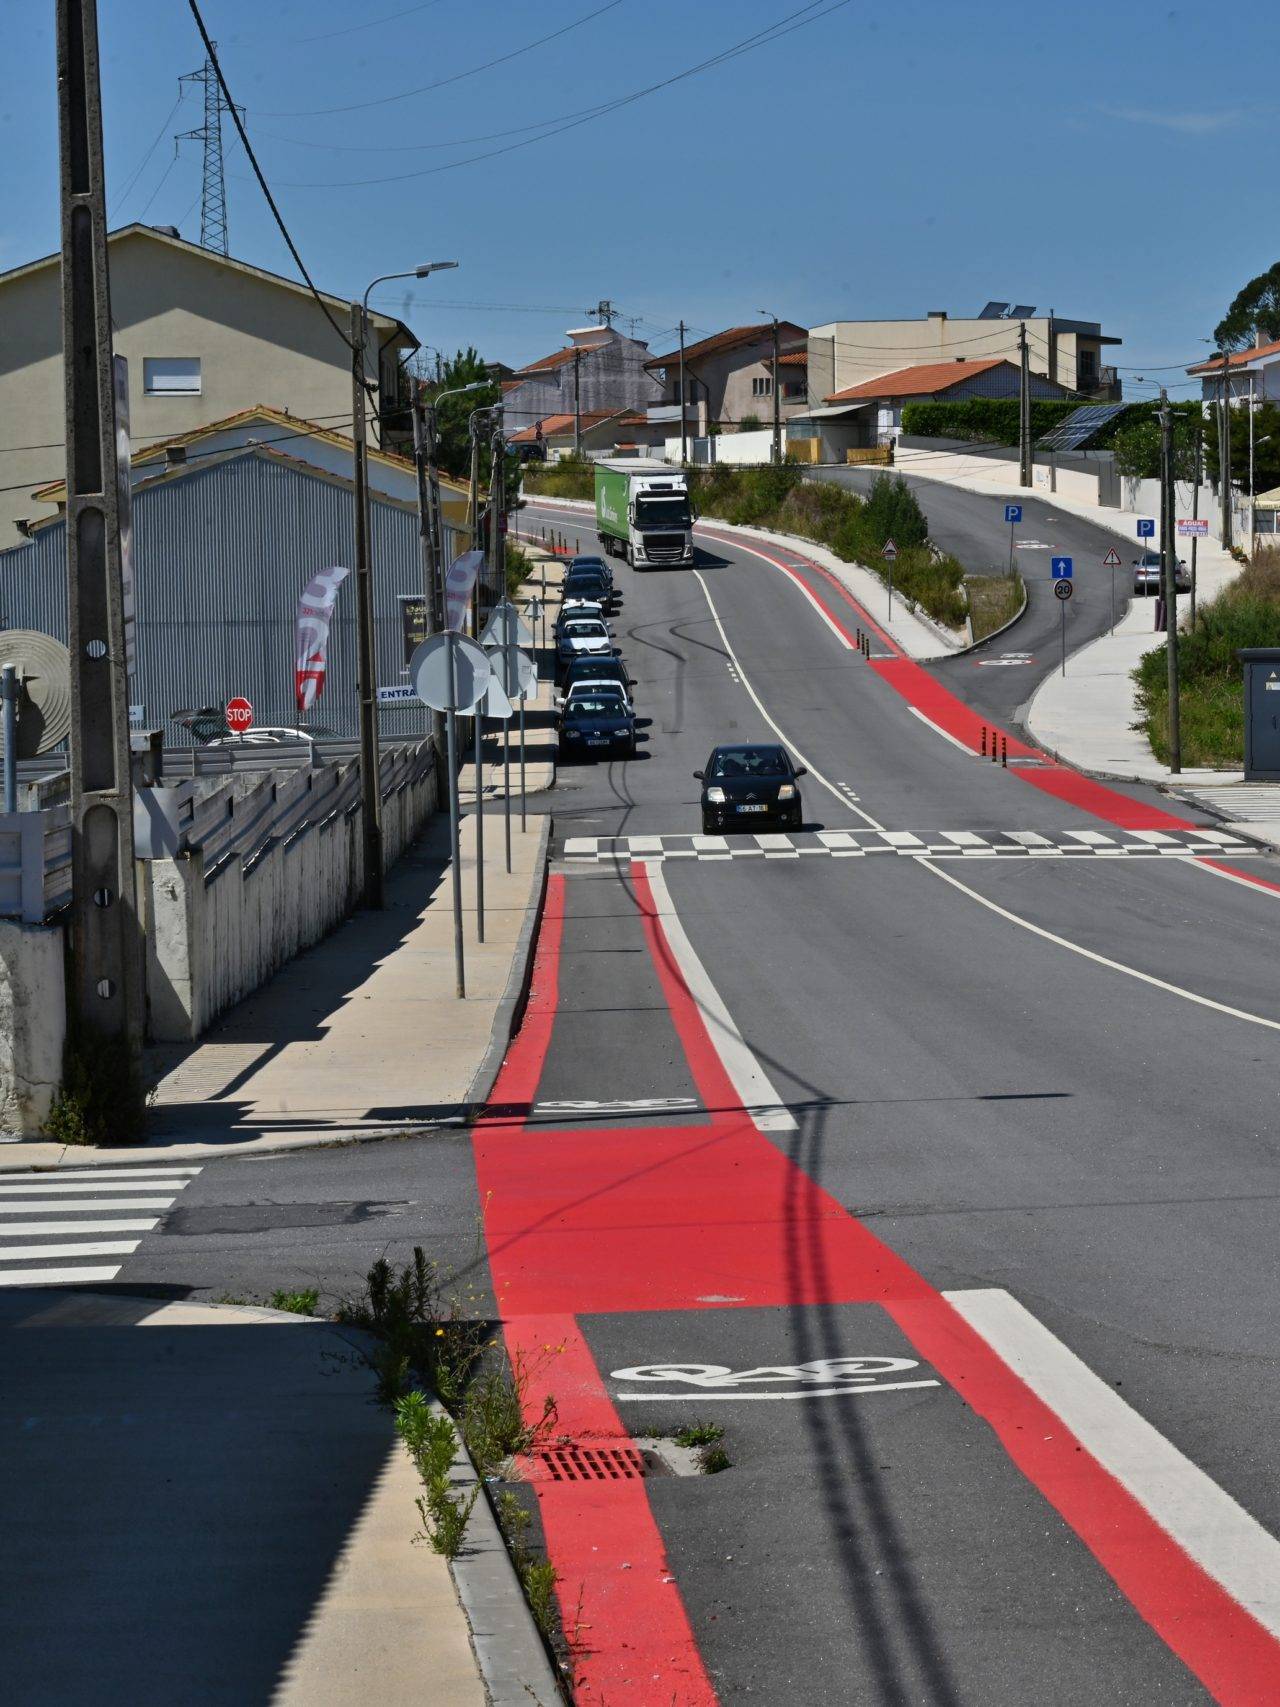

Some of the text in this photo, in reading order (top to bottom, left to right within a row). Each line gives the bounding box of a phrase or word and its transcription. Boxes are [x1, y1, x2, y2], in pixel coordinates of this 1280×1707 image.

[1008, 507, 1019, 520] P
[1141, 521, 1151, 535] P
[1057, 585, 1070, 594] 20
[381, 689, 416, 699] ENTRA
[227, 709, 251, 721] STOP
